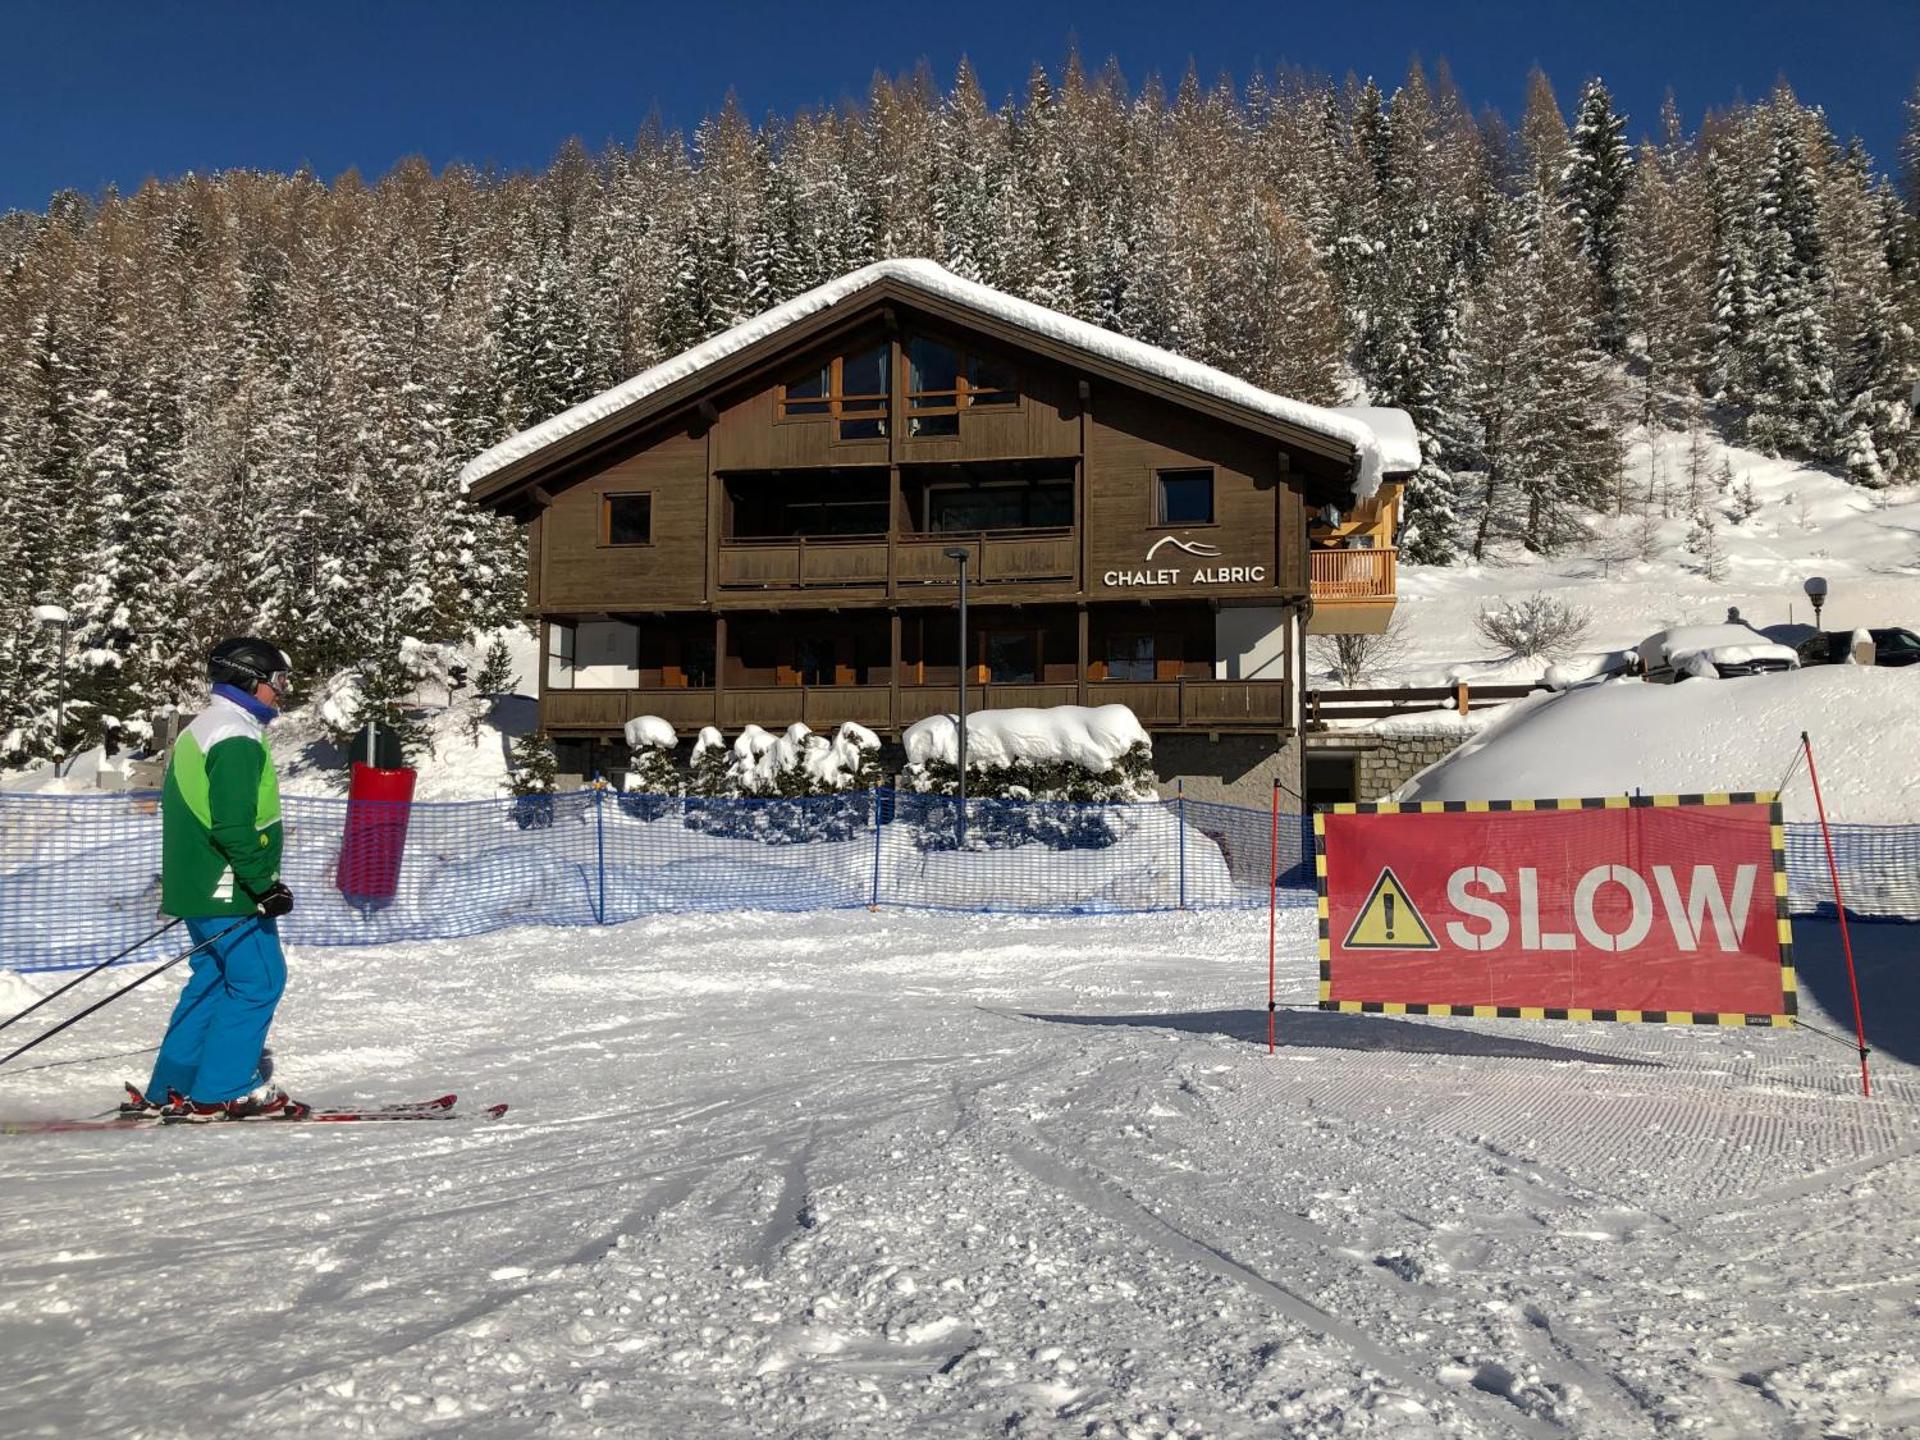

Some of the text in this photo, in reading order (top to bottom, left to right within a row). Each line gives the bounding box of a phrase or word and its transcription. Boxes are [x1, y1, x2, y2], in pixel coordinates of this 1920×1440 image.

[1104, 566, 1265, 586] CHALET ALBRIC
[1446, 864, 1758, 952] SLOW
